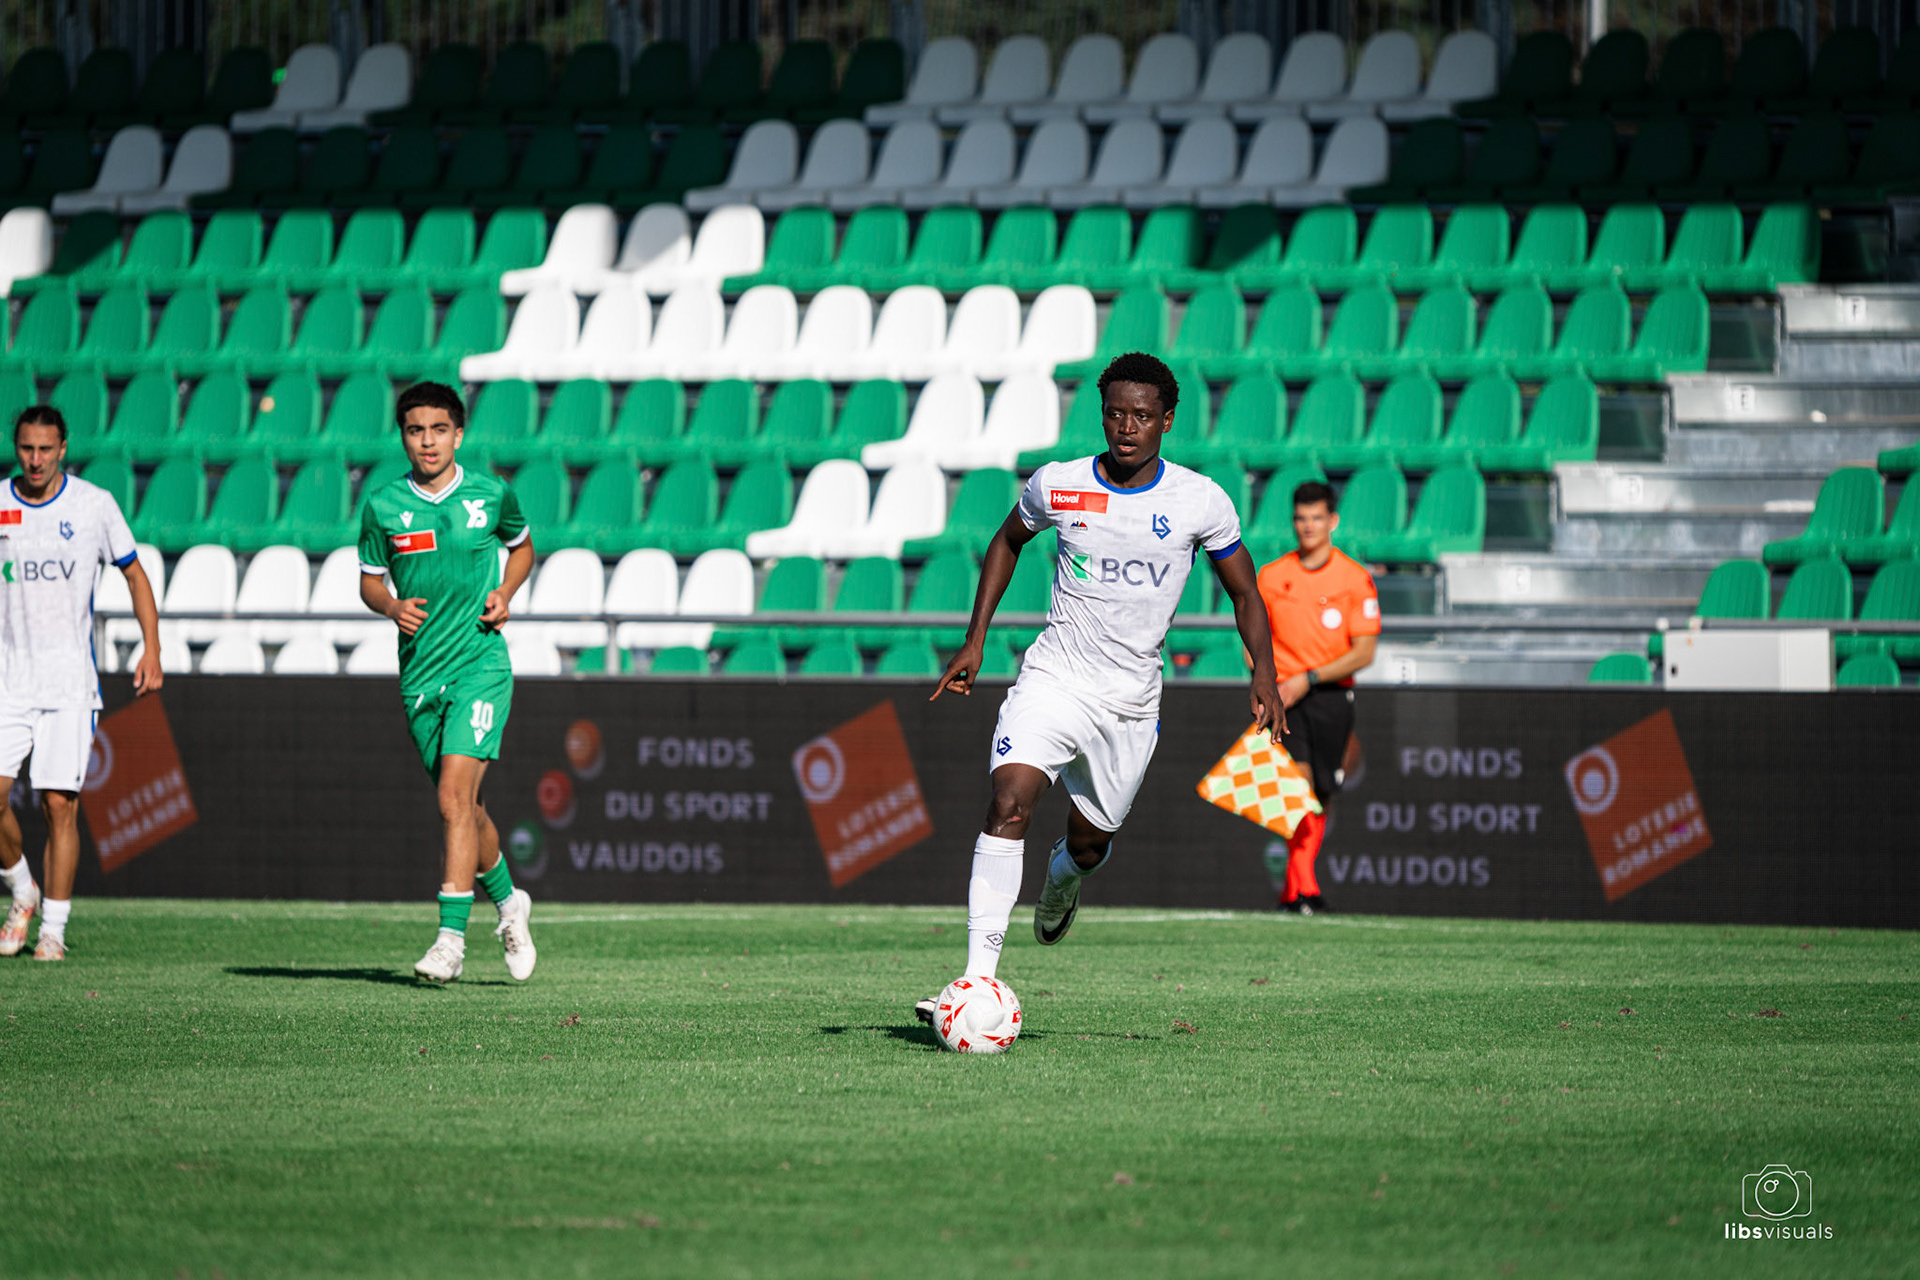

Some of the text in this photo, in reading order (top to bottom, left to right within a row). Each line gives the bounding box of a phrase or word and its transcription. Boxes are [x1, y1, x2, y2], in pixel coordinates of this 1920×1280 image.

[1053, 492, 1079, 504] Hoval
[24, 560, 75, 580] BCV
[1101, 558, 1170, 587] BCV
[470, 700, 494, 732] 10
[638, 737, 754, 769] FONDS
[1402, 748, 1523, 778] FONDS
[604, 791, 771, 822] DU SPORT
[1367, 803, 1542, 835] DU SPORT
[1613, 792, 1697, 851] LOTERIE
[569, 841, 724, 873] VAUDOIS
[1329, 855, 1490, 886] VAUDOIS
